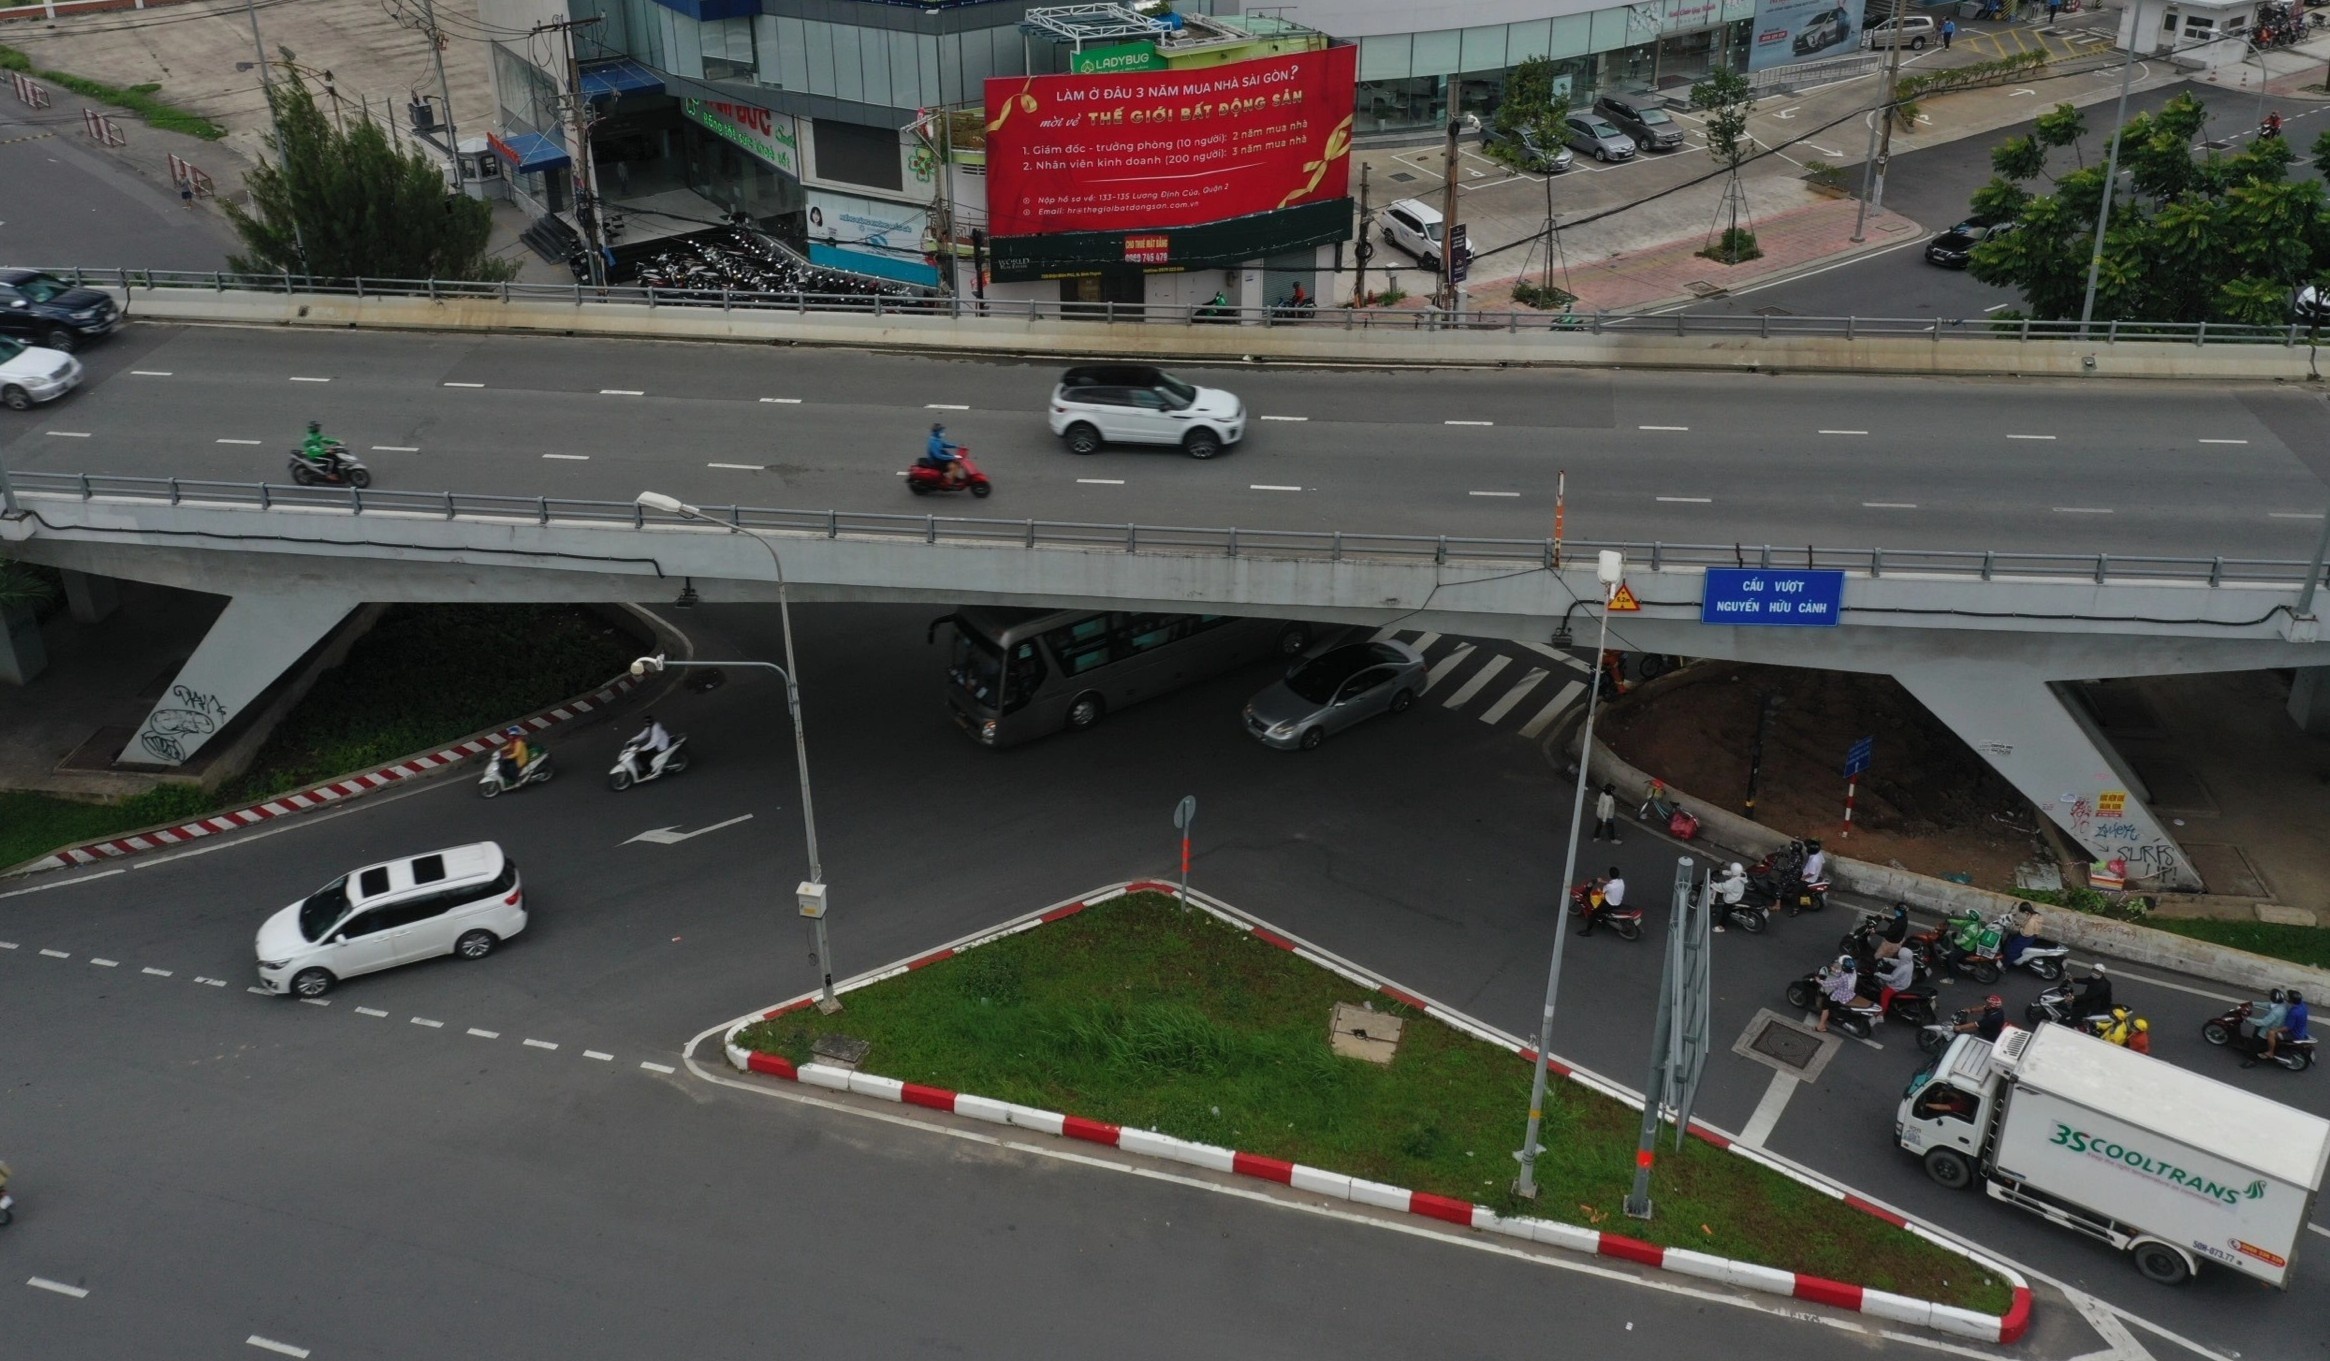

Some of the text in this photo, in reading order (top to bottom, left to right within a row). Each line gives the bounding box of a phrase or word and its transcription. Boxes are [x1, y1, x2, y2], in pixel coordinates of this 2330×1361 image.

[1096, 53, 1149, 70] LADYBUG
[1056, 64, 1299, 102] LÀM Ở ĐÂU 3 NĂM MUA NHÀ SÀI GÒN?
[1040, 88, 1303, 128] mời về THẾ GIỚI BẤT ĐỘNG SẢN
[1022, 146, 1030, 155] 1.
[1033, 144, 1062, 155] Giám
[1065, 142, 1086, 154] đốc
[1096, 140, 1134, 154] trưởng
[1137, 139, 1173, 152] phòng
[1176, 138, 1190, 150] (10
[1232, 132, 1238, 141] 2
[1241, 128, 1262, 139] năm
[1266, 126, 1287, 134] mua
[1290, 120, 1308, 131] nhà
[1023, 162, 1033, 171] 2.
[1036, 160, 1066, 170] Nhân
[1070, 158, 1094, 169] viên
[1097, 156, 1122, 167] kinh
[1126, 155, 1161, 166] doanh
[1165, 154, 1190, 165] (200
[1232, 146, 1238, 156] 3
[1240, 144, 1262, 154] năm
[1265, 141, 1286, 149] mua
[1289, 134, 1307, 146] nhà
[1038, 196, 1055, 205] Nộp
[1058, 194, 1068, 203] hồ
[1099, 192, 1130, 201] 133-135
[1132, 191, 1158, 200] Lương
[1161, 189, 1180, 199] Định
[1224, 182, 1229, 190] 2
[1743, 577, 1805, 595] CẦU VƯỢT
[1716, 598, 1827, 614] NGUYỄN HỮU CẢNH
[2117, 845, 2174, 866] SURFS
